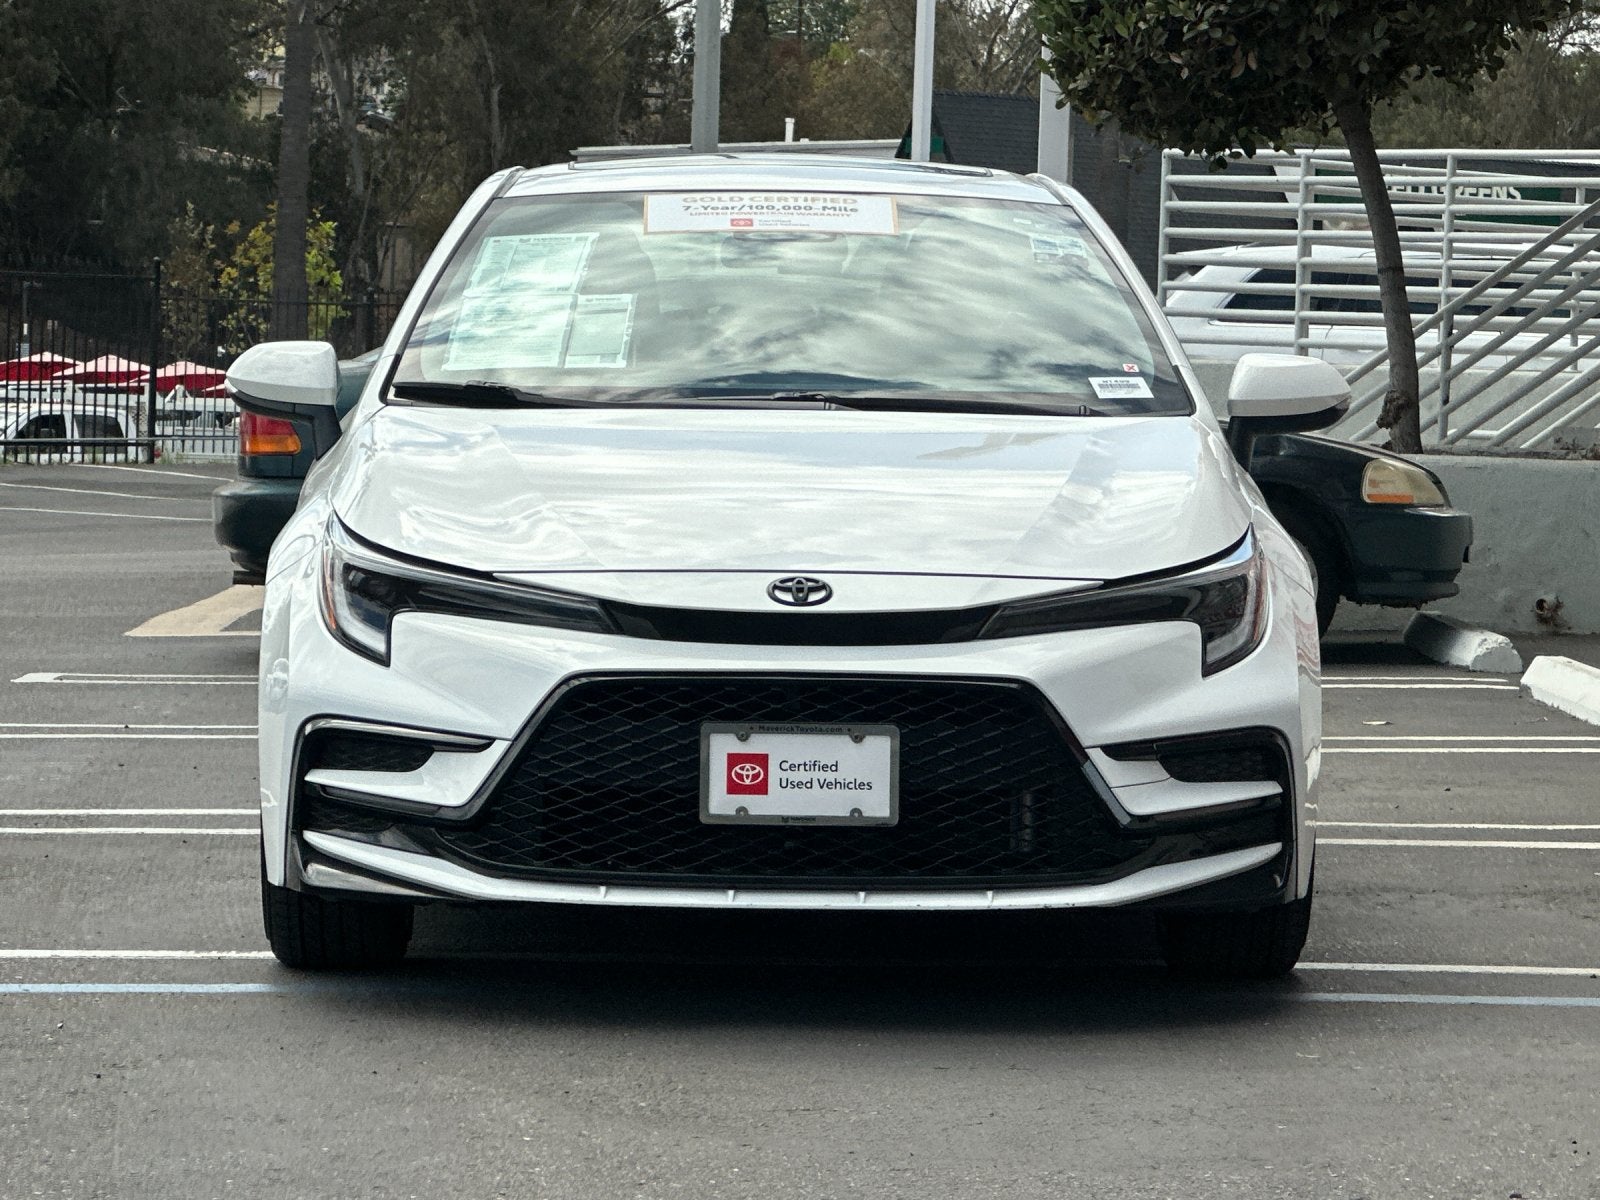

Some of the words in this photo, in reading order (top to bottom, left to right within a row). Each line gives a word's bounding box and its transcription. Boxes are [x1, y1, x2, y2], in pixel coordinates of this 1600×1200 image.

[748, 196, 858, 205] CERTIFIED
[682, 204, 859, 213] 7-Year/100,000-Mile
[758, 725, 843, 733] MaverickToyota.com
[779, 759, 839, 773] Certified
[779, 777, 813, 790] Used
[817, 778, 873, 791] Vehicles
